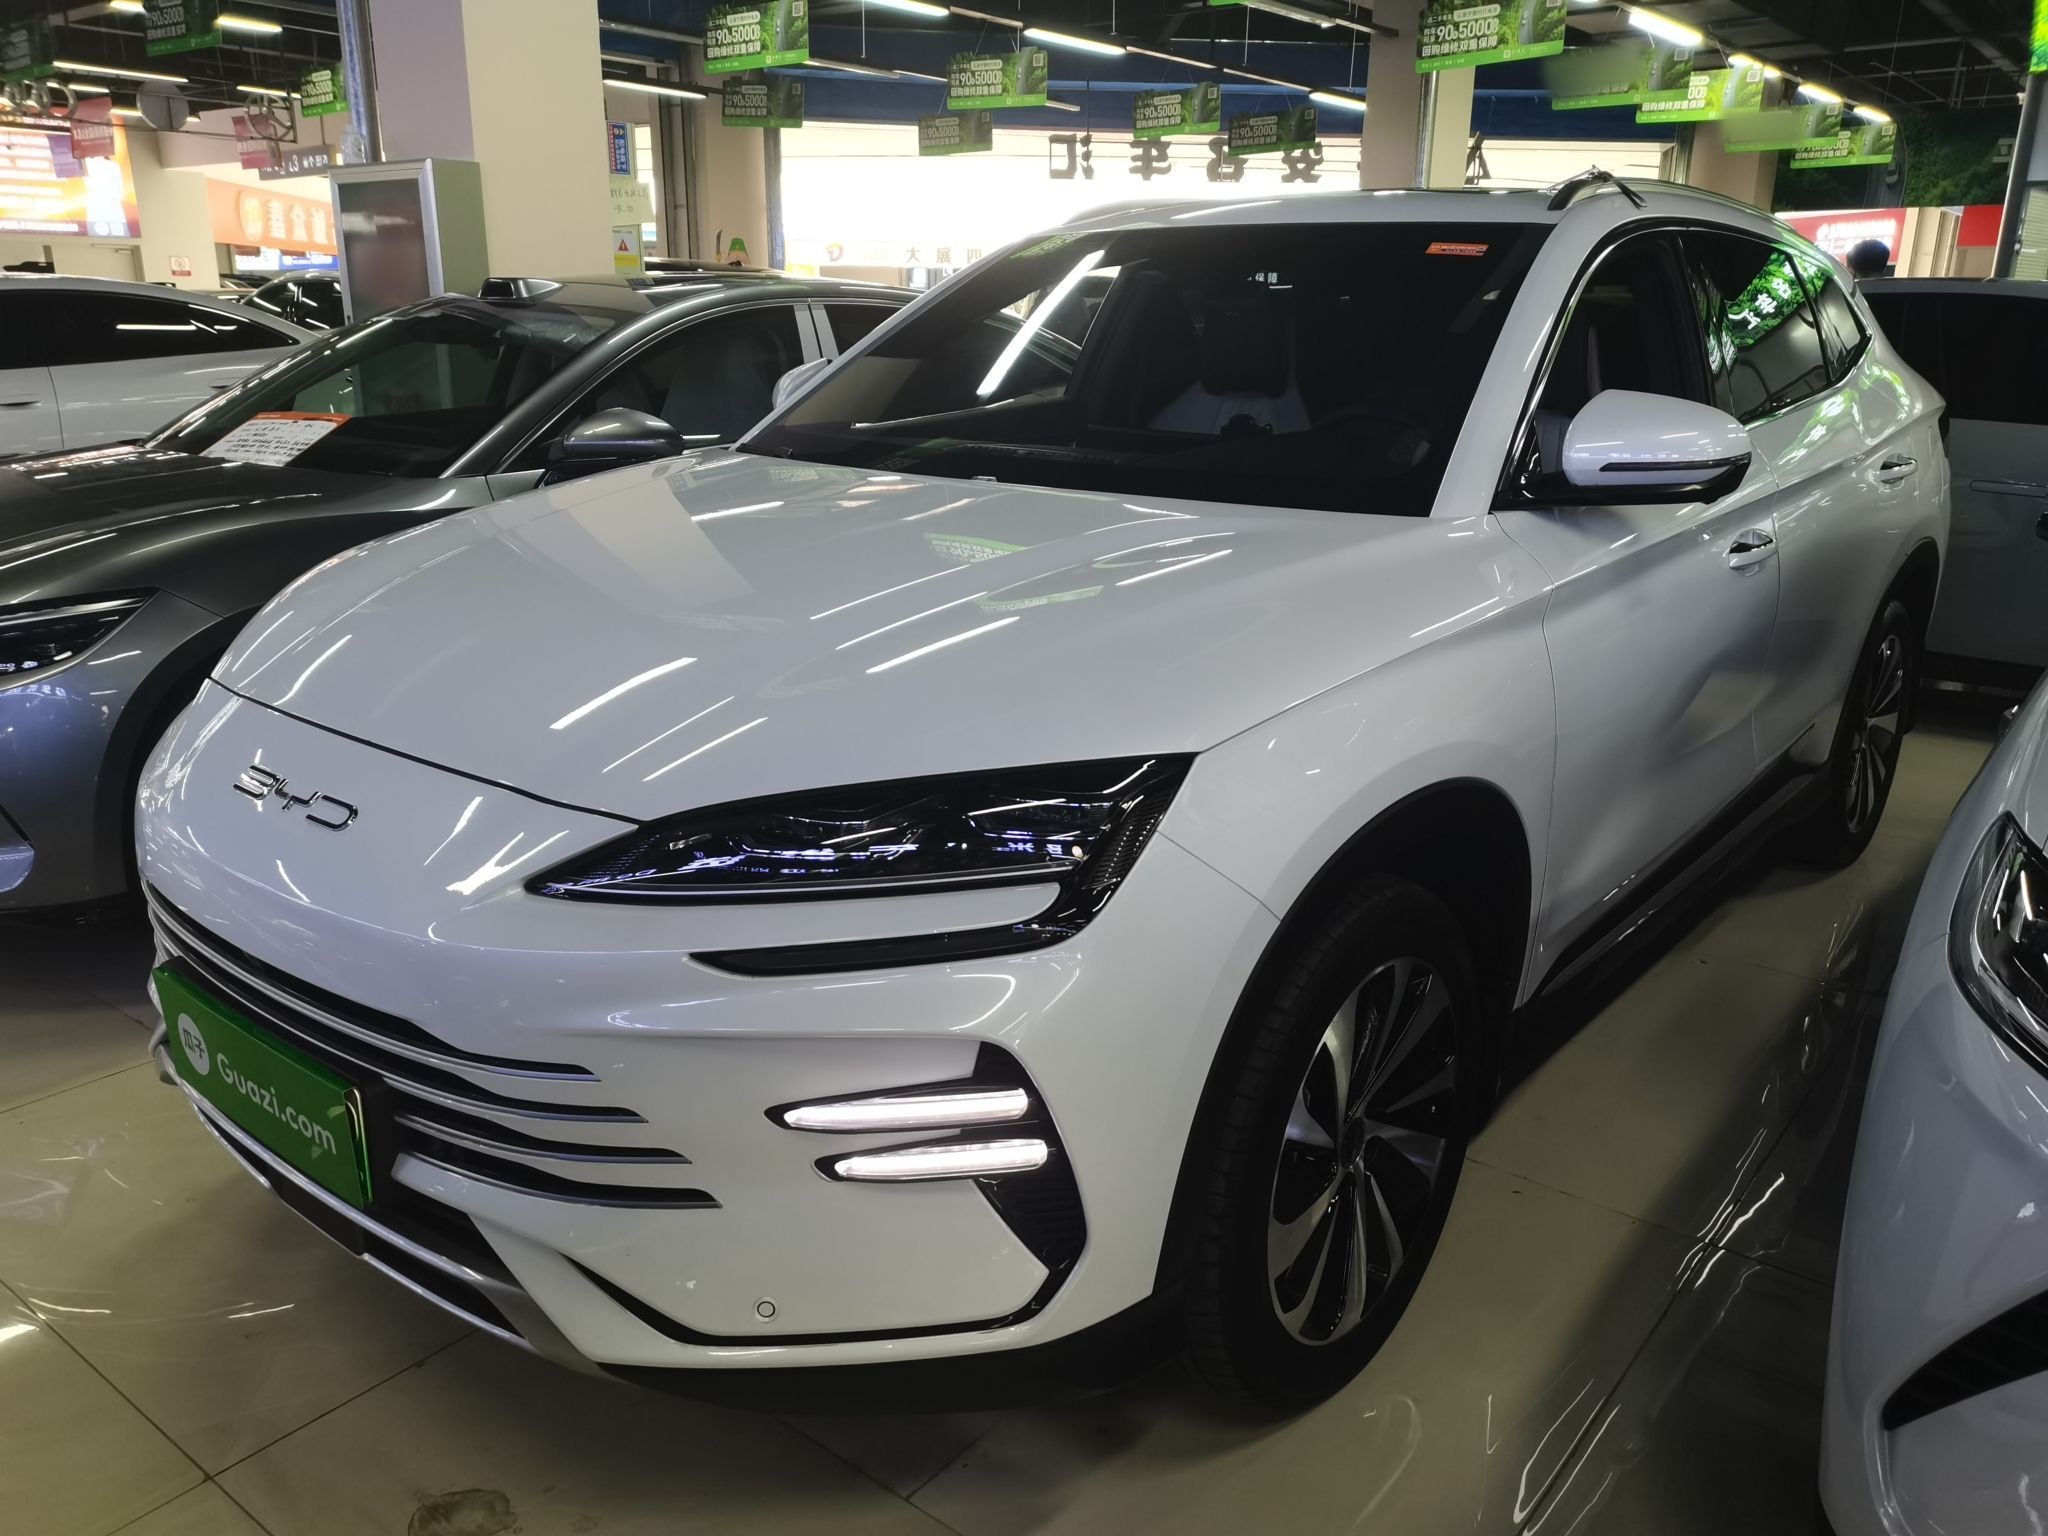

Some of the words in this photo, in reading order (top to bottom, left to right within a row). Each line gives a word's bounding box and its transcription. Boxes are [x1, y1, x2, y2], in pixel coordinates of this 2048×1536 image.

[233, 765, 358, 832] BYD
[182, 1026, 206, 1060] 瓜子
[216, 1052, 337, 1156] Guazi.com
